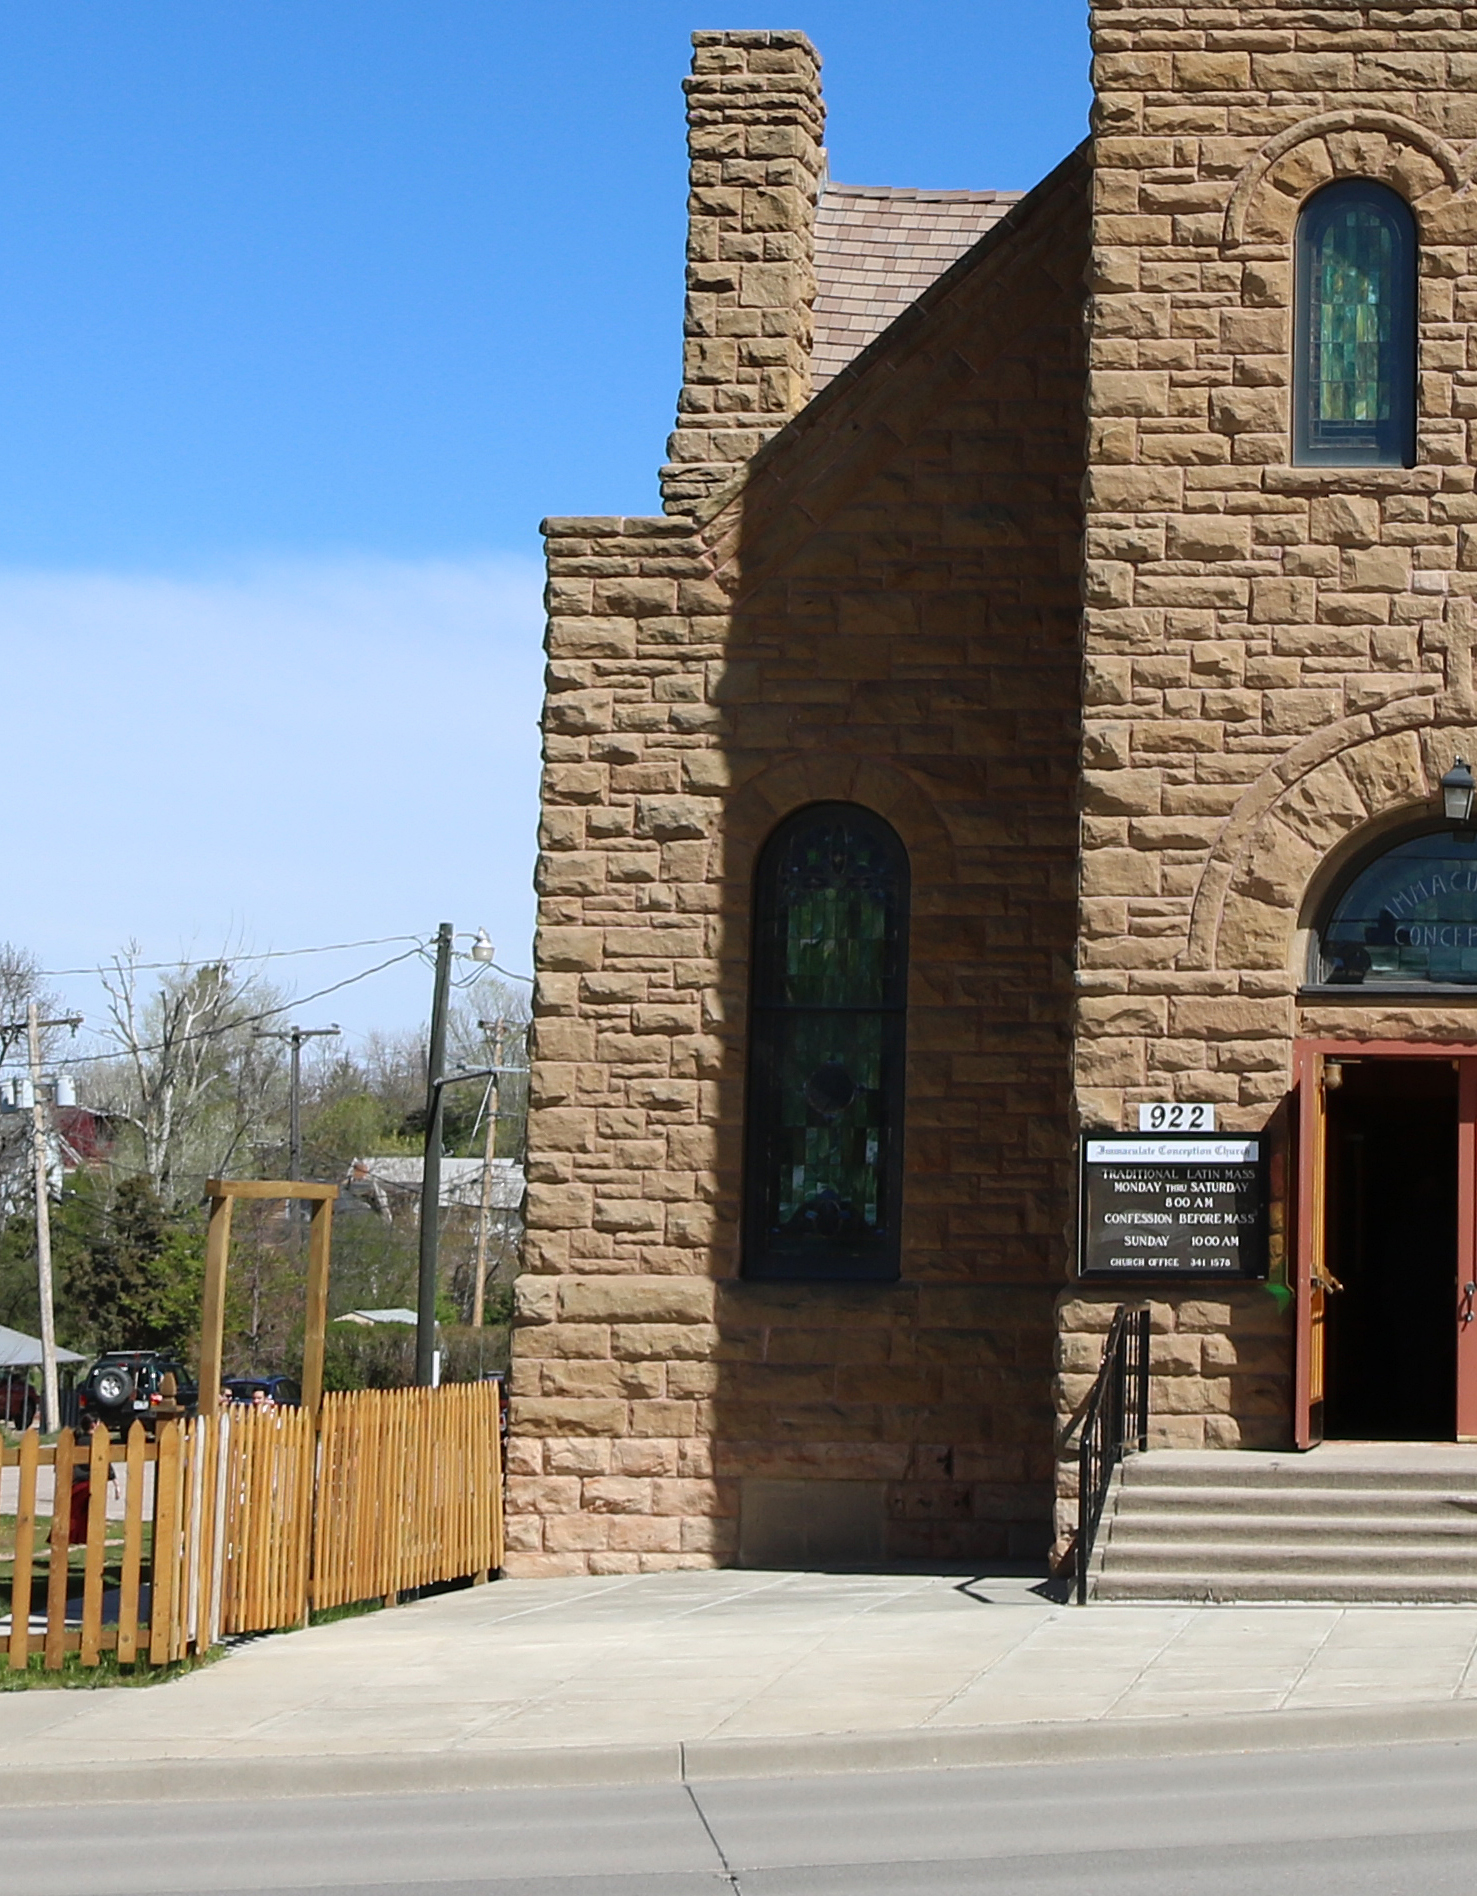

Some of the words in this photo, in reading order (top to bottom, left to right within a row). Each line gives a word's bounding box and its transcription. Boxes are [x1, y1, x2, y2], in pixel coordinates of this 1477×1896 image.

[1150, 1105, 1205, 1129] 922
[1097, 1144, 1156, 1156] Immaculate
[1158, 1145, 1212, 1158] Conception
[1214, 1145, 1251, 1158] Church
[1102, 1168, 1179, 1180] TRADITIONAL
[1186, 1168, 1220, 1180] LATIN
[1224, 1168, 1256, 1180] MASS
[1114, 1181, 1162, 1193] MONDAY
[1165, 1184, 1188, 1193] THRU
[1190, 1181, 1249, 1193] SATURDAY
[1104, 1213, 1173, 1225] CONFESSION
[1179, 1213, 1222, 1225] BEFORE
[1224, 1213, 1255, 1225] MASS
[1124, 1235, 1170, 1247] SUNDAY
[1221, 1236, 1239, 1247] AM
[1110, 1257, 1145, 1267] CHURCH
[1148, 1257, 1180, 1267] OFFICE
